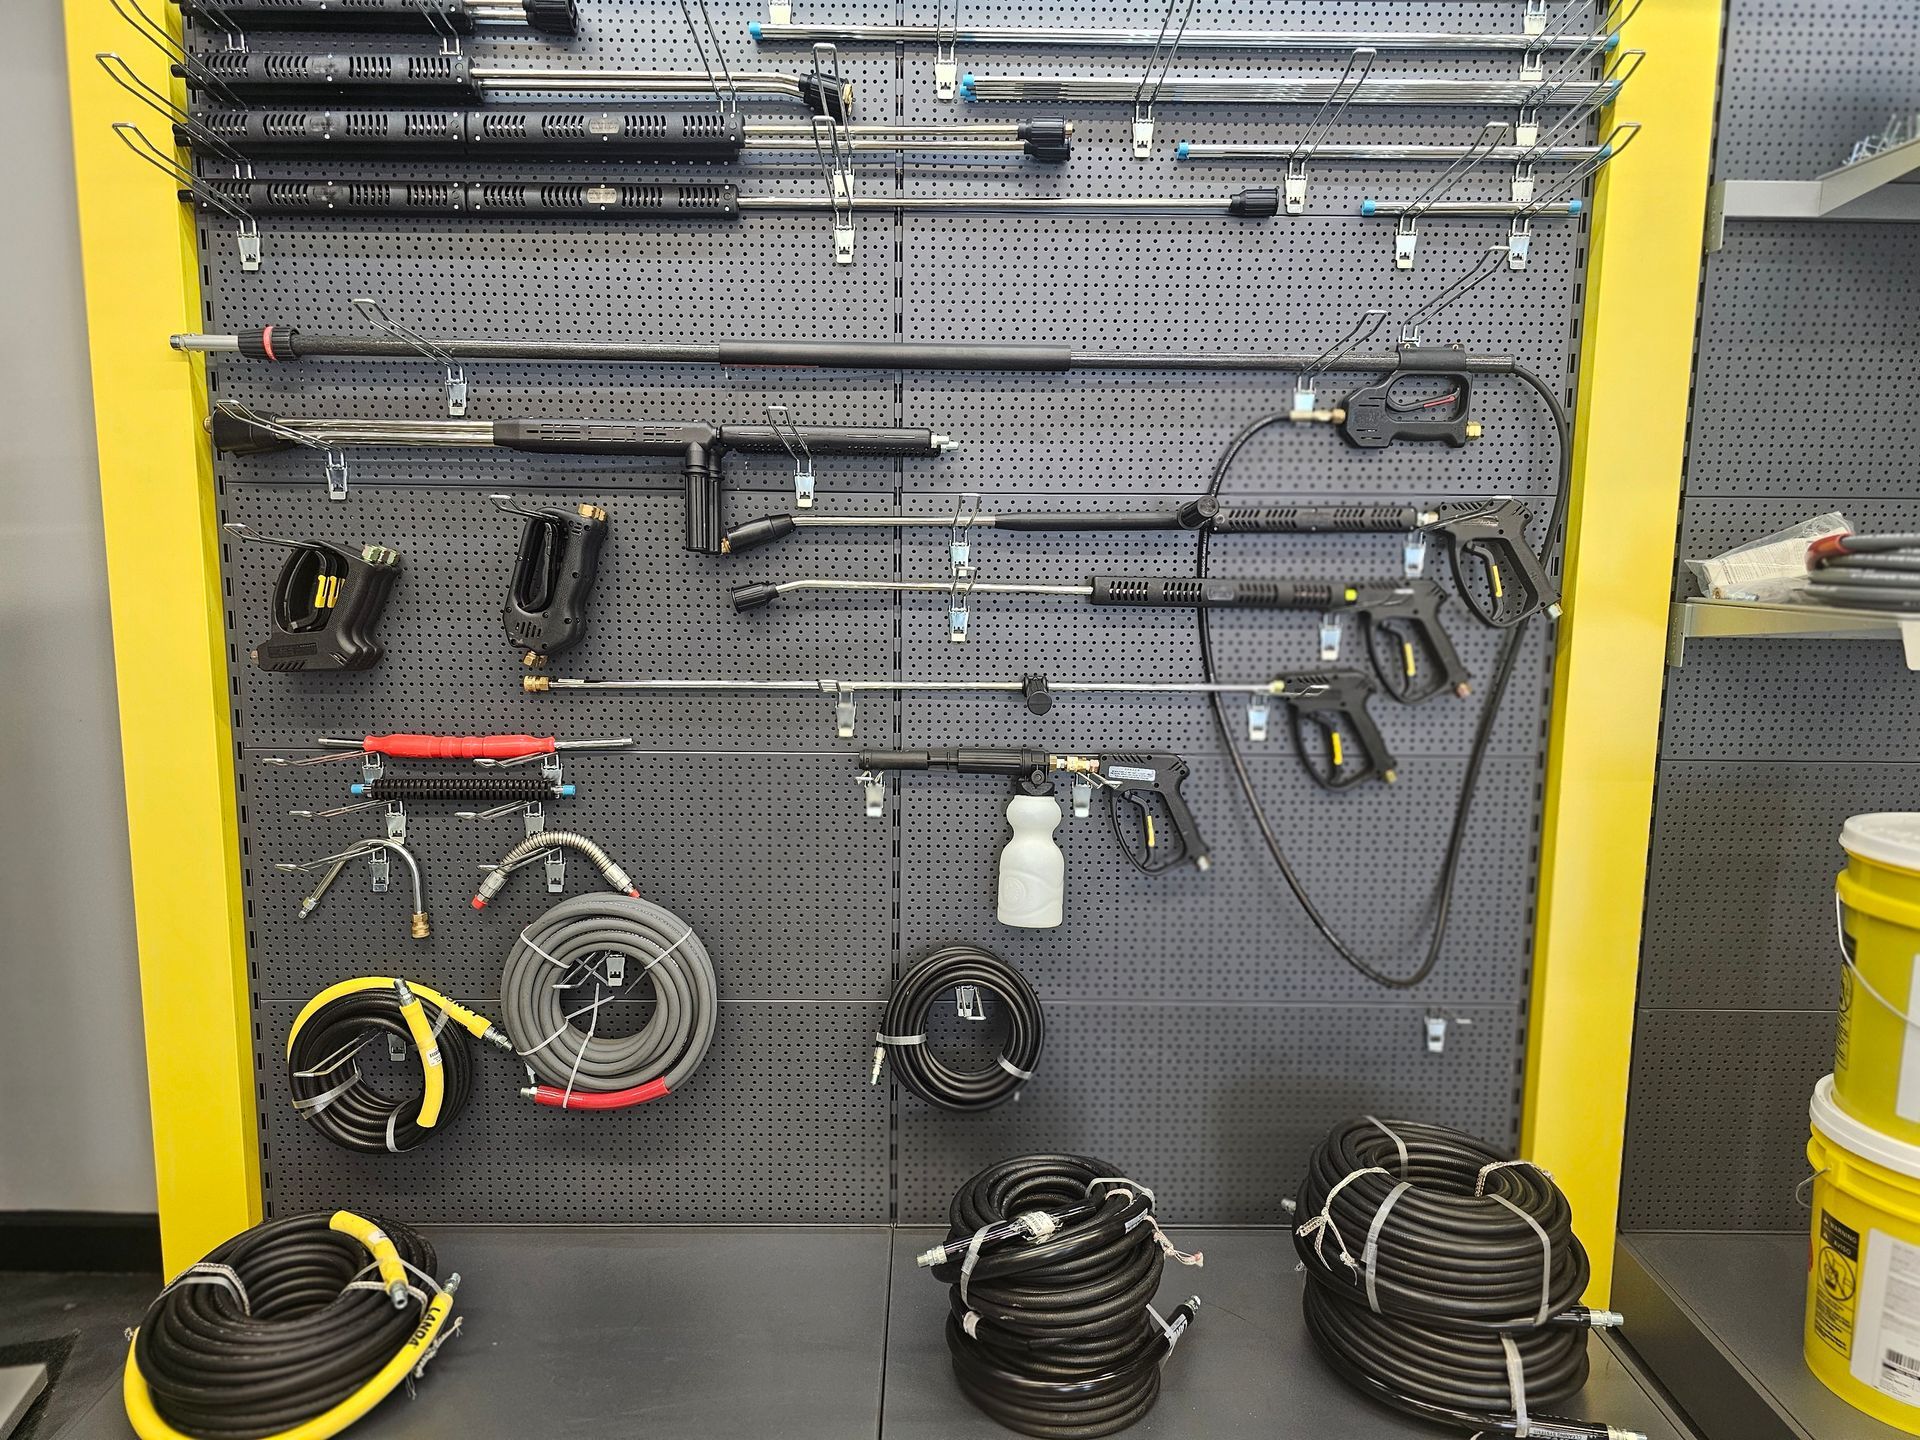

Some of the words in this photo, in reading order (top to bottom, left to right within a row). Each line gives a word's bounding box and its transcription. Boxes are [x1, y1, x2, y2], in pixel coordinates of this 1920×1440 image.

[1829, 1222, 1857, 1243] WARNING
[1833, 1240, 1852, 1255] AVISO
[407, 1307, 441, 1347] LANDA
